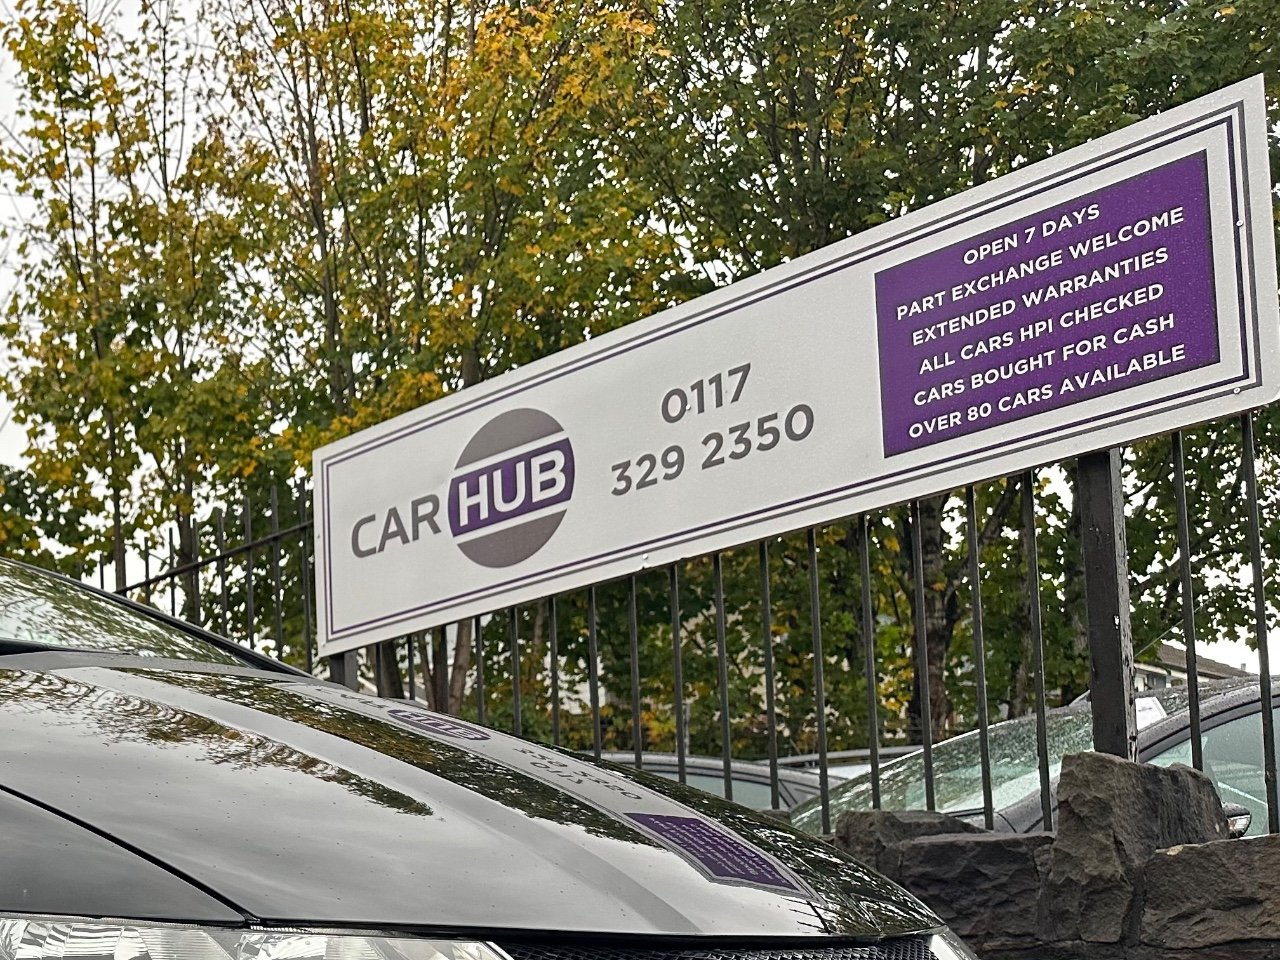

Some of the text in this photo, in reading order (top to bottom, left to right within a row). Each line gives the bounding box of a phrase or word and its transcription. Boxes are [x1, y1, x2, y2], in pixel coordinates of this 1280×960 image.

[896, 207, 1185, 321] PART EXCHANGE WELCOME
[963, 204, 1100, 265] OPEN 7 DAYS
[912, 247, 1169, 346] EXTENDED WARRANTIES
[919, 283, 1164, 375] ALL CARS HPI CHECKED
[661, 362, 751, 424] 0117
[908, 344, 1186, 439] OVER 80 CARS AVAILABLE
[913, 313, 1175, 407] CARS BOUGHT FOR CASH
[611, 404, 815, 497] 329 2350
[350, 448, 567, 559] CAR HUB
